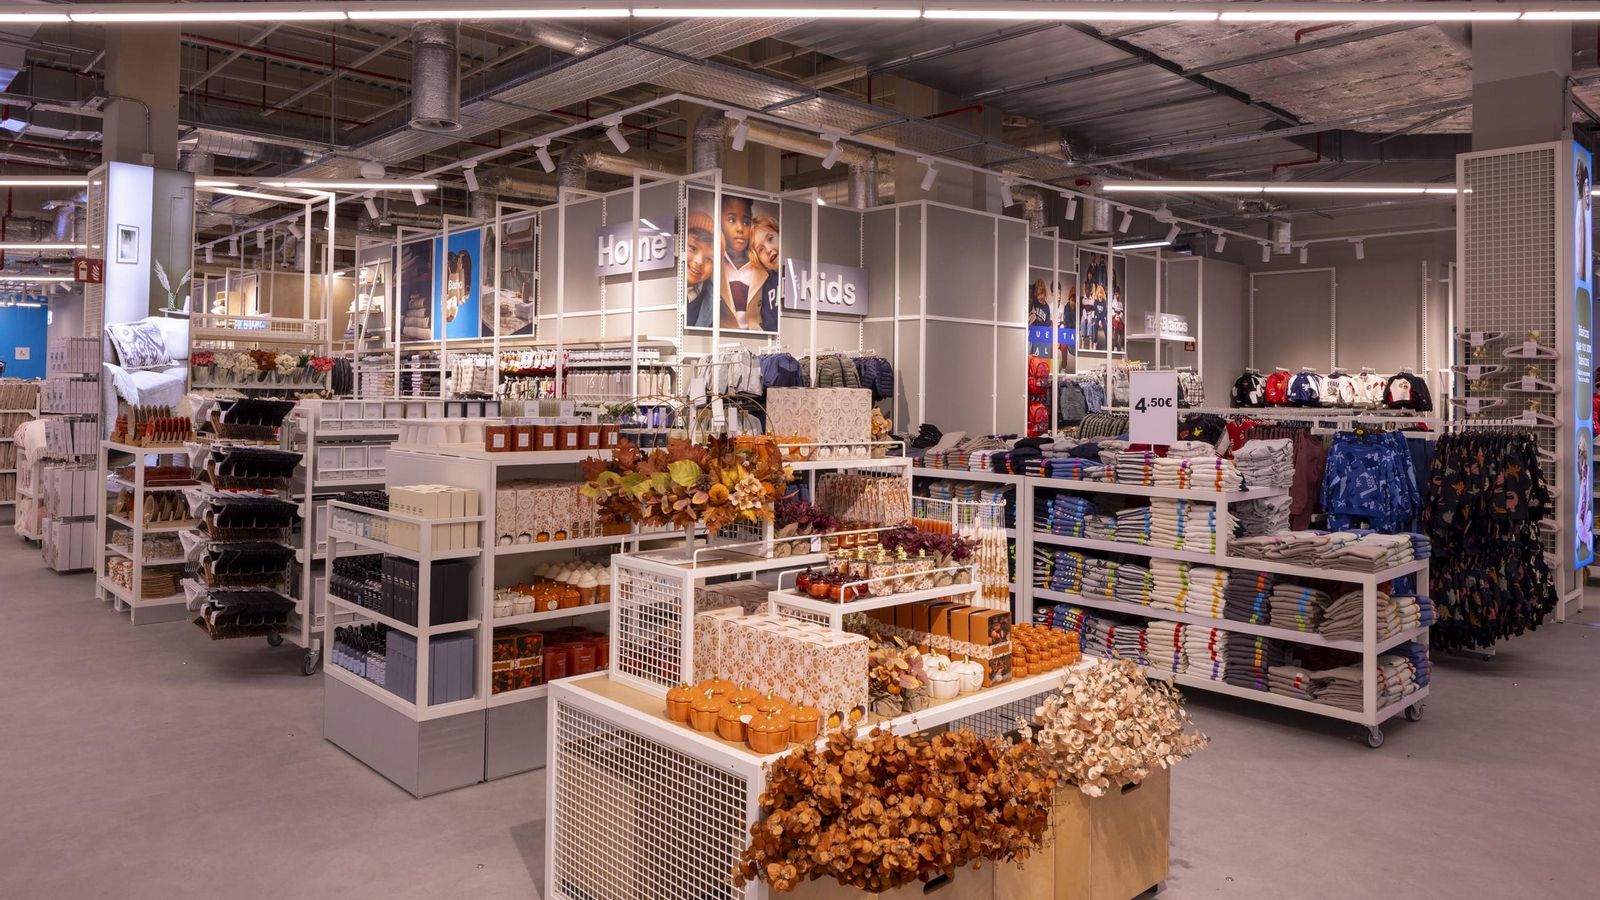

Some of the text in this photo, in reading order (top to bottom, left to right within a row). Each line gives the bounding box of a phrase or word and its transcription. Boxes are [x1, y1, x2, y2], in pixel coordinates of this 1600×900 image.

[598, 235, 668, 268] Home
[800, 270, 856, 306] Kids
[1134, 397, 1173, 414] 4.50€
